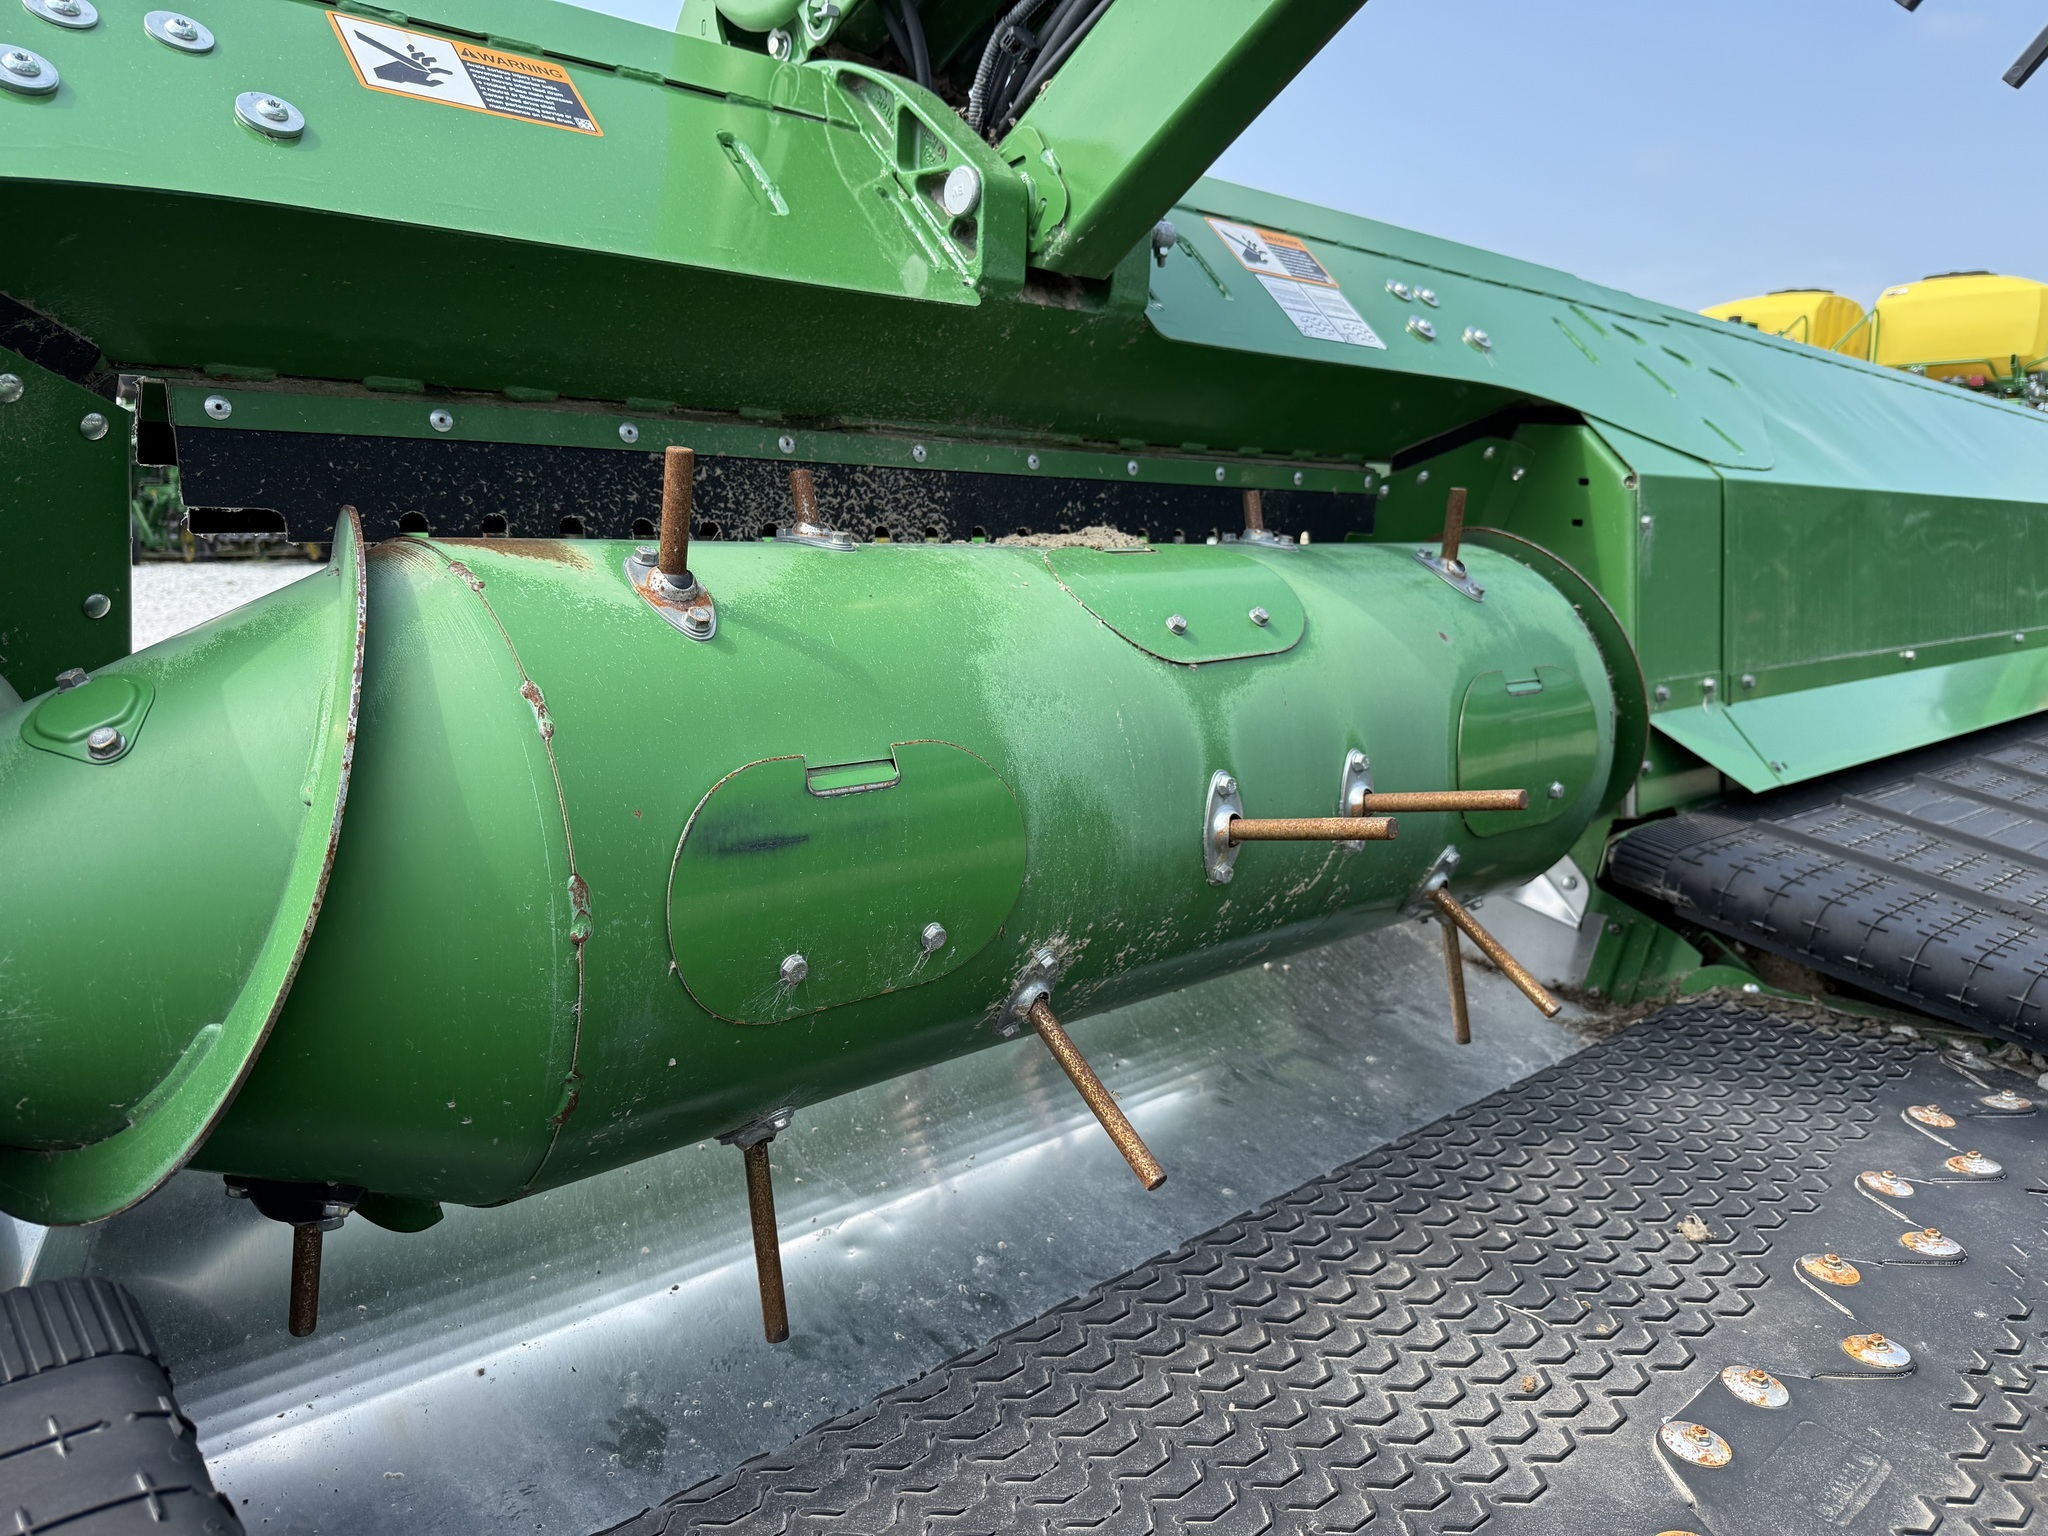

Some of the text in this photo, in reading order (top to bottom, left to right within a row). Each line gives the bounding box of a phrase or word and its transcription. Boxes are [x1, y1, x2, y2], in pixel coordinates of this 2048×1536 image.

[466, 62, 485, 70] Avoid
[476, 52, 563, 79] WARNING
[469, 68, 504, 79] movement
[491, 78, 513, 86] moves
[487, 87, 510, 96] neutral
[486, 97, 504, 105] when
[505, 102, 541, 113] performing
[541, 110, 565, 118] service
[488, 103, 531, 116] maintenance
